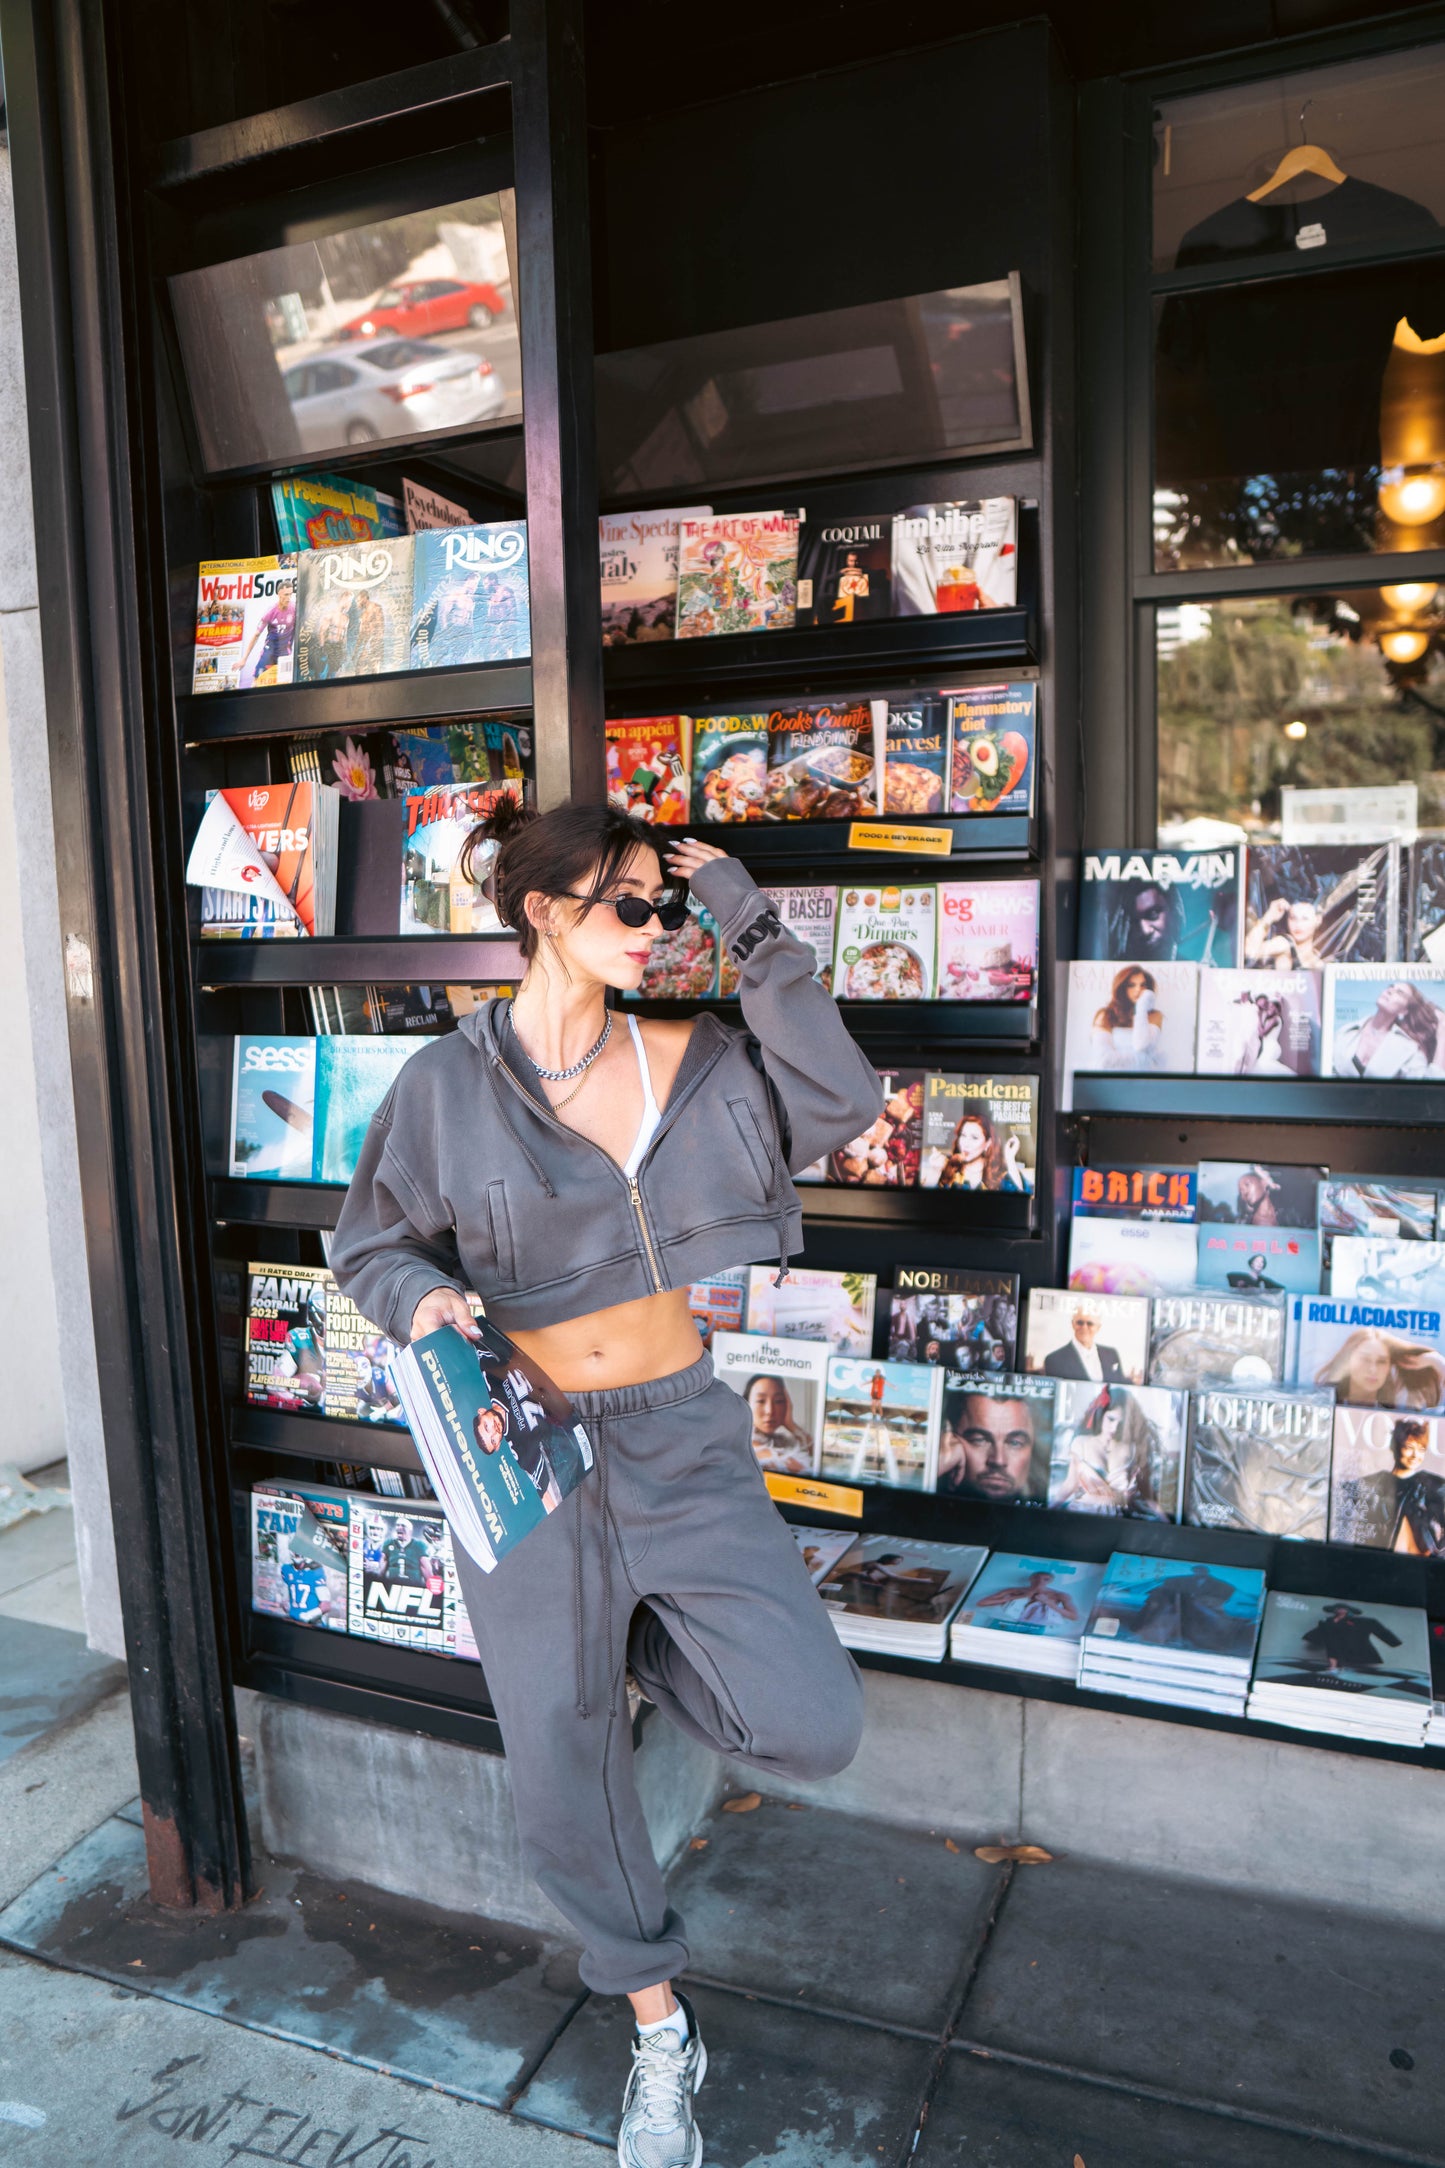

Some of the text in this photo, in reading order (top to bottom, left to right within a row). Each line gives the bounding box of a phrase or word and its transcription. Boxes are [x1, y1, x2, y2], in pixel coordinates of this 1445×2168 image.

[682, 522, 707, 538] THE
[713, 519, 736, 537] ART
[742, 518, 758, 533] OF
[821, 524, 881, 542] COQTAIL
[898, 509, 985, 538] imbibe
[601, 549, 626, 558] astes
[601, 557, 638, 580] taly
[768, 706, 872, 733] Cook's Country
[960, 718, 986, 732] diet
[858, 832, 883, 840] FOOD
[891, 833, 942, 843] BEVERAGES
[1084, 852, 1235, 881] MARVIN
[790, 888, 824, 898] KNIVES
[789, 899, 832, 919] BASED
[854, 923, 918, 945] Dinners
[405, 1013, 438, 1028] RECLAIM
[930, 1078, 1031, 1100] Pasadena
[989, 1101, 1003, 1111] THE
[1003, 1101, 1020, 1112] BEST
[993, 1110, 1031, 1123] PASADENA
[1082, 1170, 1189, 1206] BRICK
[1141, 1209, 1192, 1217] AMAARAE
[267, 1268, 293, 1276] RATED
[295, 1271, 320, 1279] DRAFT
[728, 1273, 747, 1282] LIFE
[770, 1273, 799, 1286] RAL
[250, 1308, 279, 1319] 2025
[251, 1298, 299, 1312] FOOTBALL
[1309, 1301, 1440, 1332] ROLLACOASTER
[326, 1331, 363, 1351] INDEX
[761, 1342, 780, 1356] the
[727, 1351, 812, 1369] gentlewoman
[829, 1357, 886, 1391] GQ
[946, 1379, 1055, 1399] Esquire
[508, 1369, 546, 1431] 75
[421, 1351, 504, 1544] Wonderland
[796, 1488, 829, 1499] LOCAL
[258, 1510, 297, 1534] FAN
[290, 1584, 310, 1609] 17
[366, 1581, 444, 1617] NFL
[382, 1611, 441, 1626] PREVIEW
